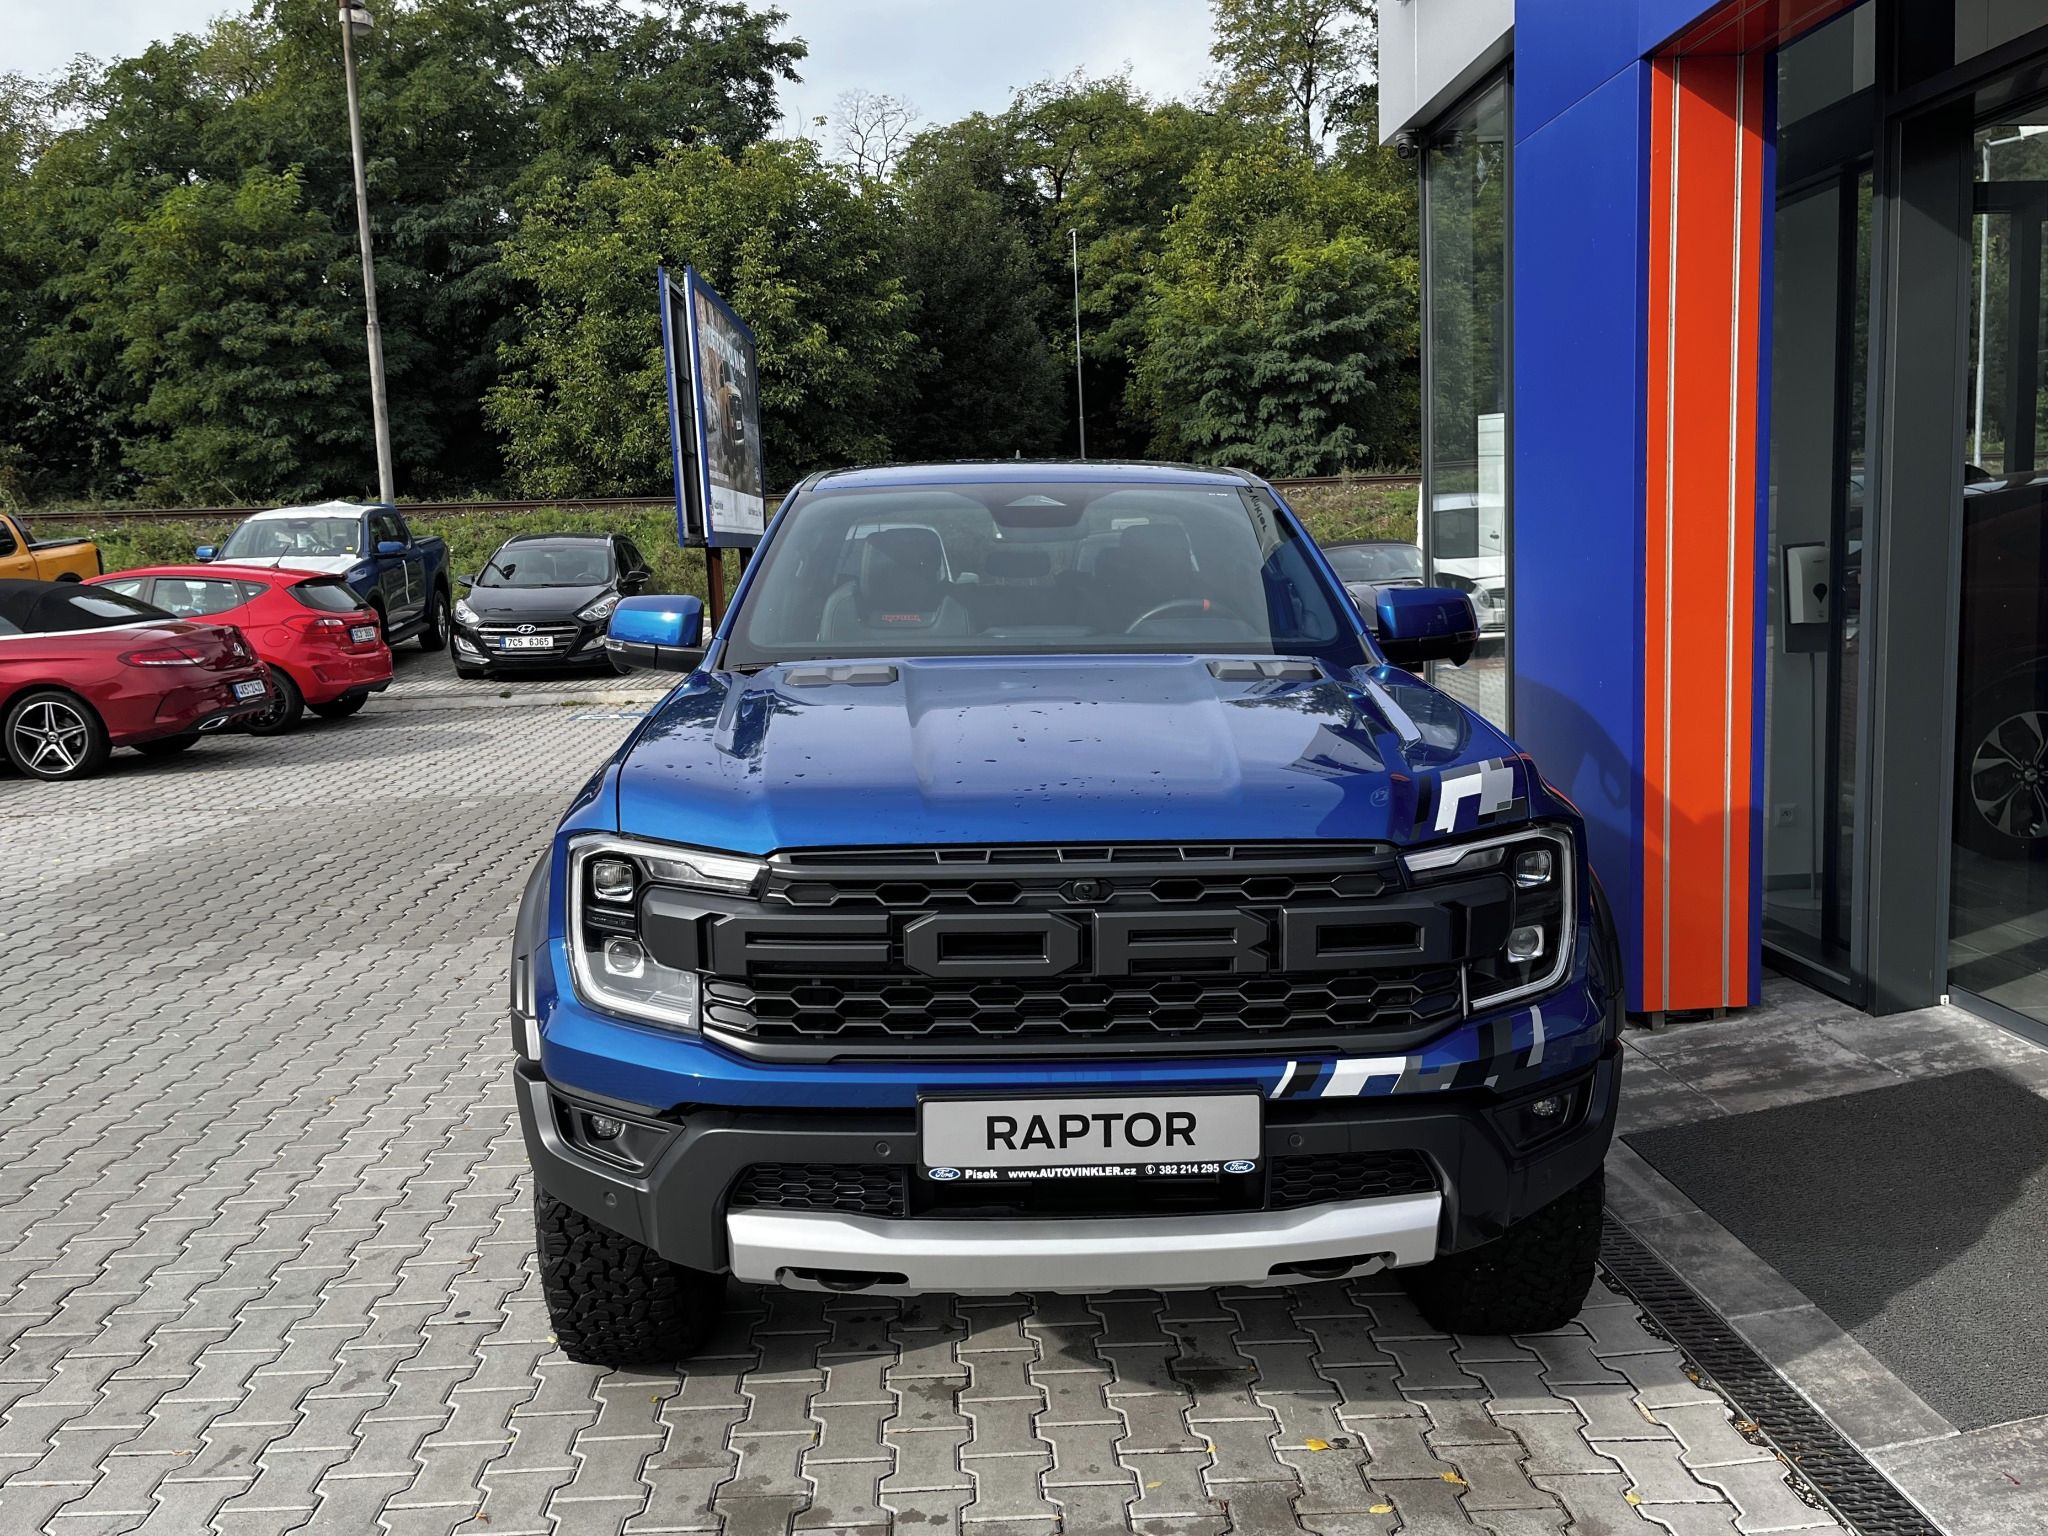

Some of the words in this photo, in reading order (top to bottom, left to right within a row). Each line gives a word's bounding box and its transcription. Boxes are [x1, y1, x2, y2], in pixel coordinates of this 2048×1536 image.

[508, 638, 523, 647] 7C5
[529, 637, 549, 646] 6365
[712, 904, 1452, 977] FORD
[986, 1111, 1197, 1151] RAPTOR
[932, 1167, 957, 1179] Ford
[965, 1168, 998, 1179] Písek
[1008, 1165, 1137, 1179] www.AUTOVINKLER.cz
[1159, 1165, 1178, 1175] 382
[1180, 1164, 1199, 1174] 214
[1201, 1163, 1220, 1173] 295
[1227, 1161, 1252, 1173] Ford
